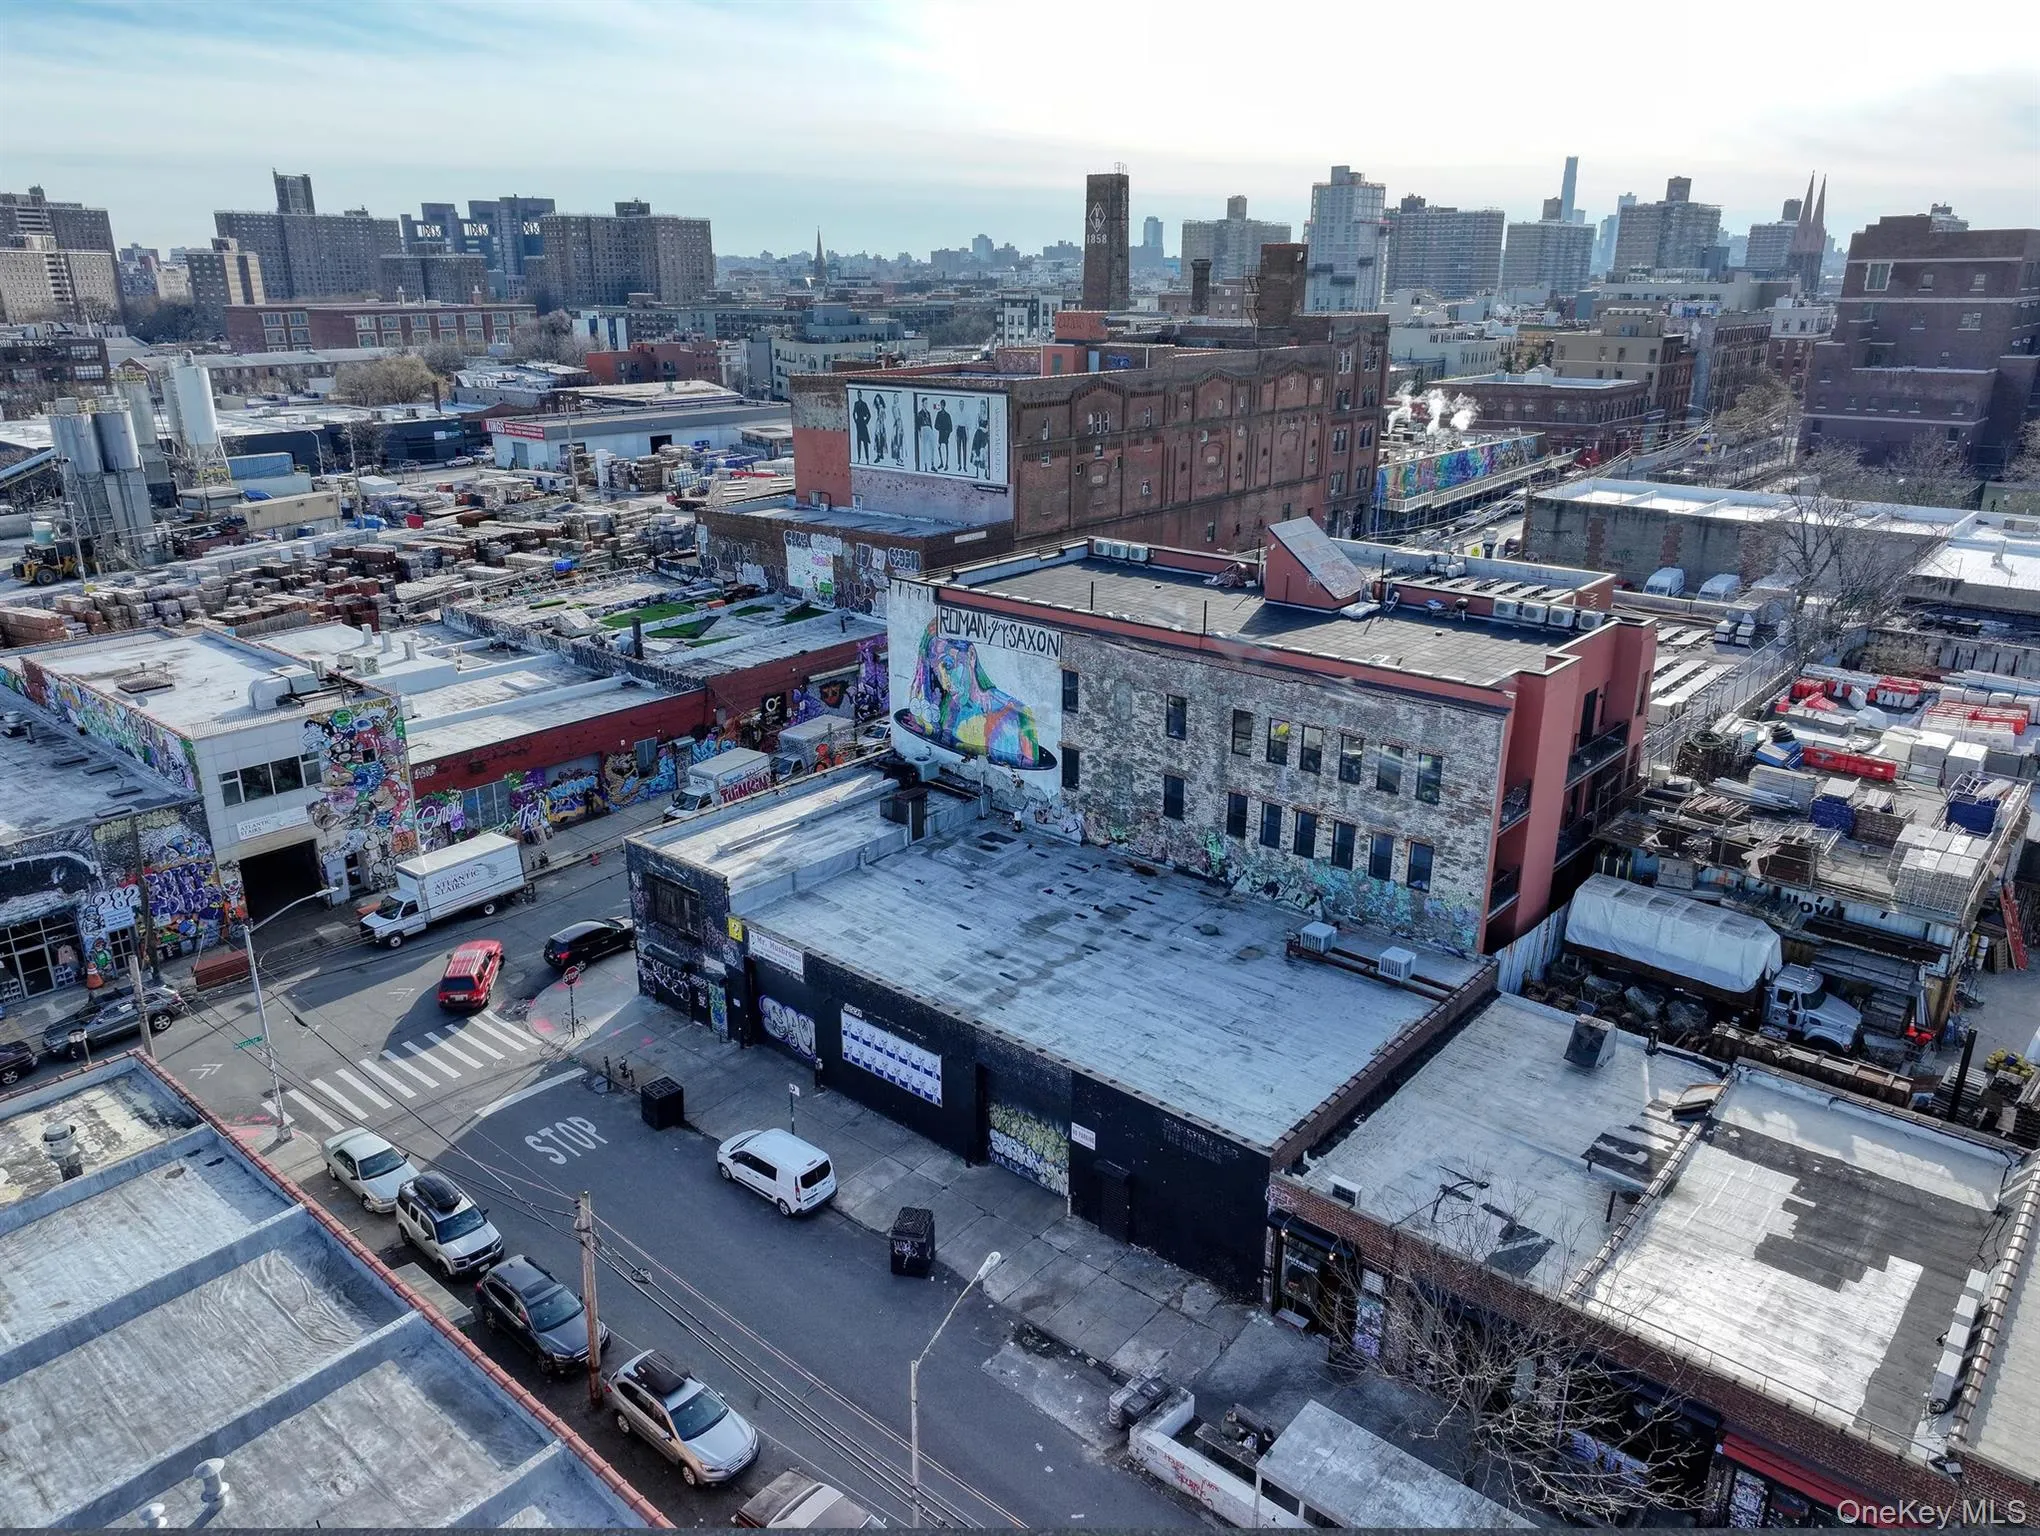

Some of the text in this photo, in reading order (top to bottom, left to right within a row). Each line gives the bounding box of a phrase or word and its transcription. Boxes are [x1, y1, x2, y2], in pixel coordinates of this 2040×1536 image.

[1087, 234, 1107, 244] 1858
[486, 420, 505, 433] KINGS
[940, 607, 987, 639] ROMAN
[1009, 623, 1060, 657] SAXON
[240, 818, 271, 832] ATLANTIC
[240, 826, 262, 836] STAIRS
[435, 868, 480, 889] ATLANTIC
[434, 881, 466, 896] STAIRS
[92, 884, 142, 915] 282
[770, 940, 801, 961] Mushroom
[525, 1117, 608, 1164] STOP
